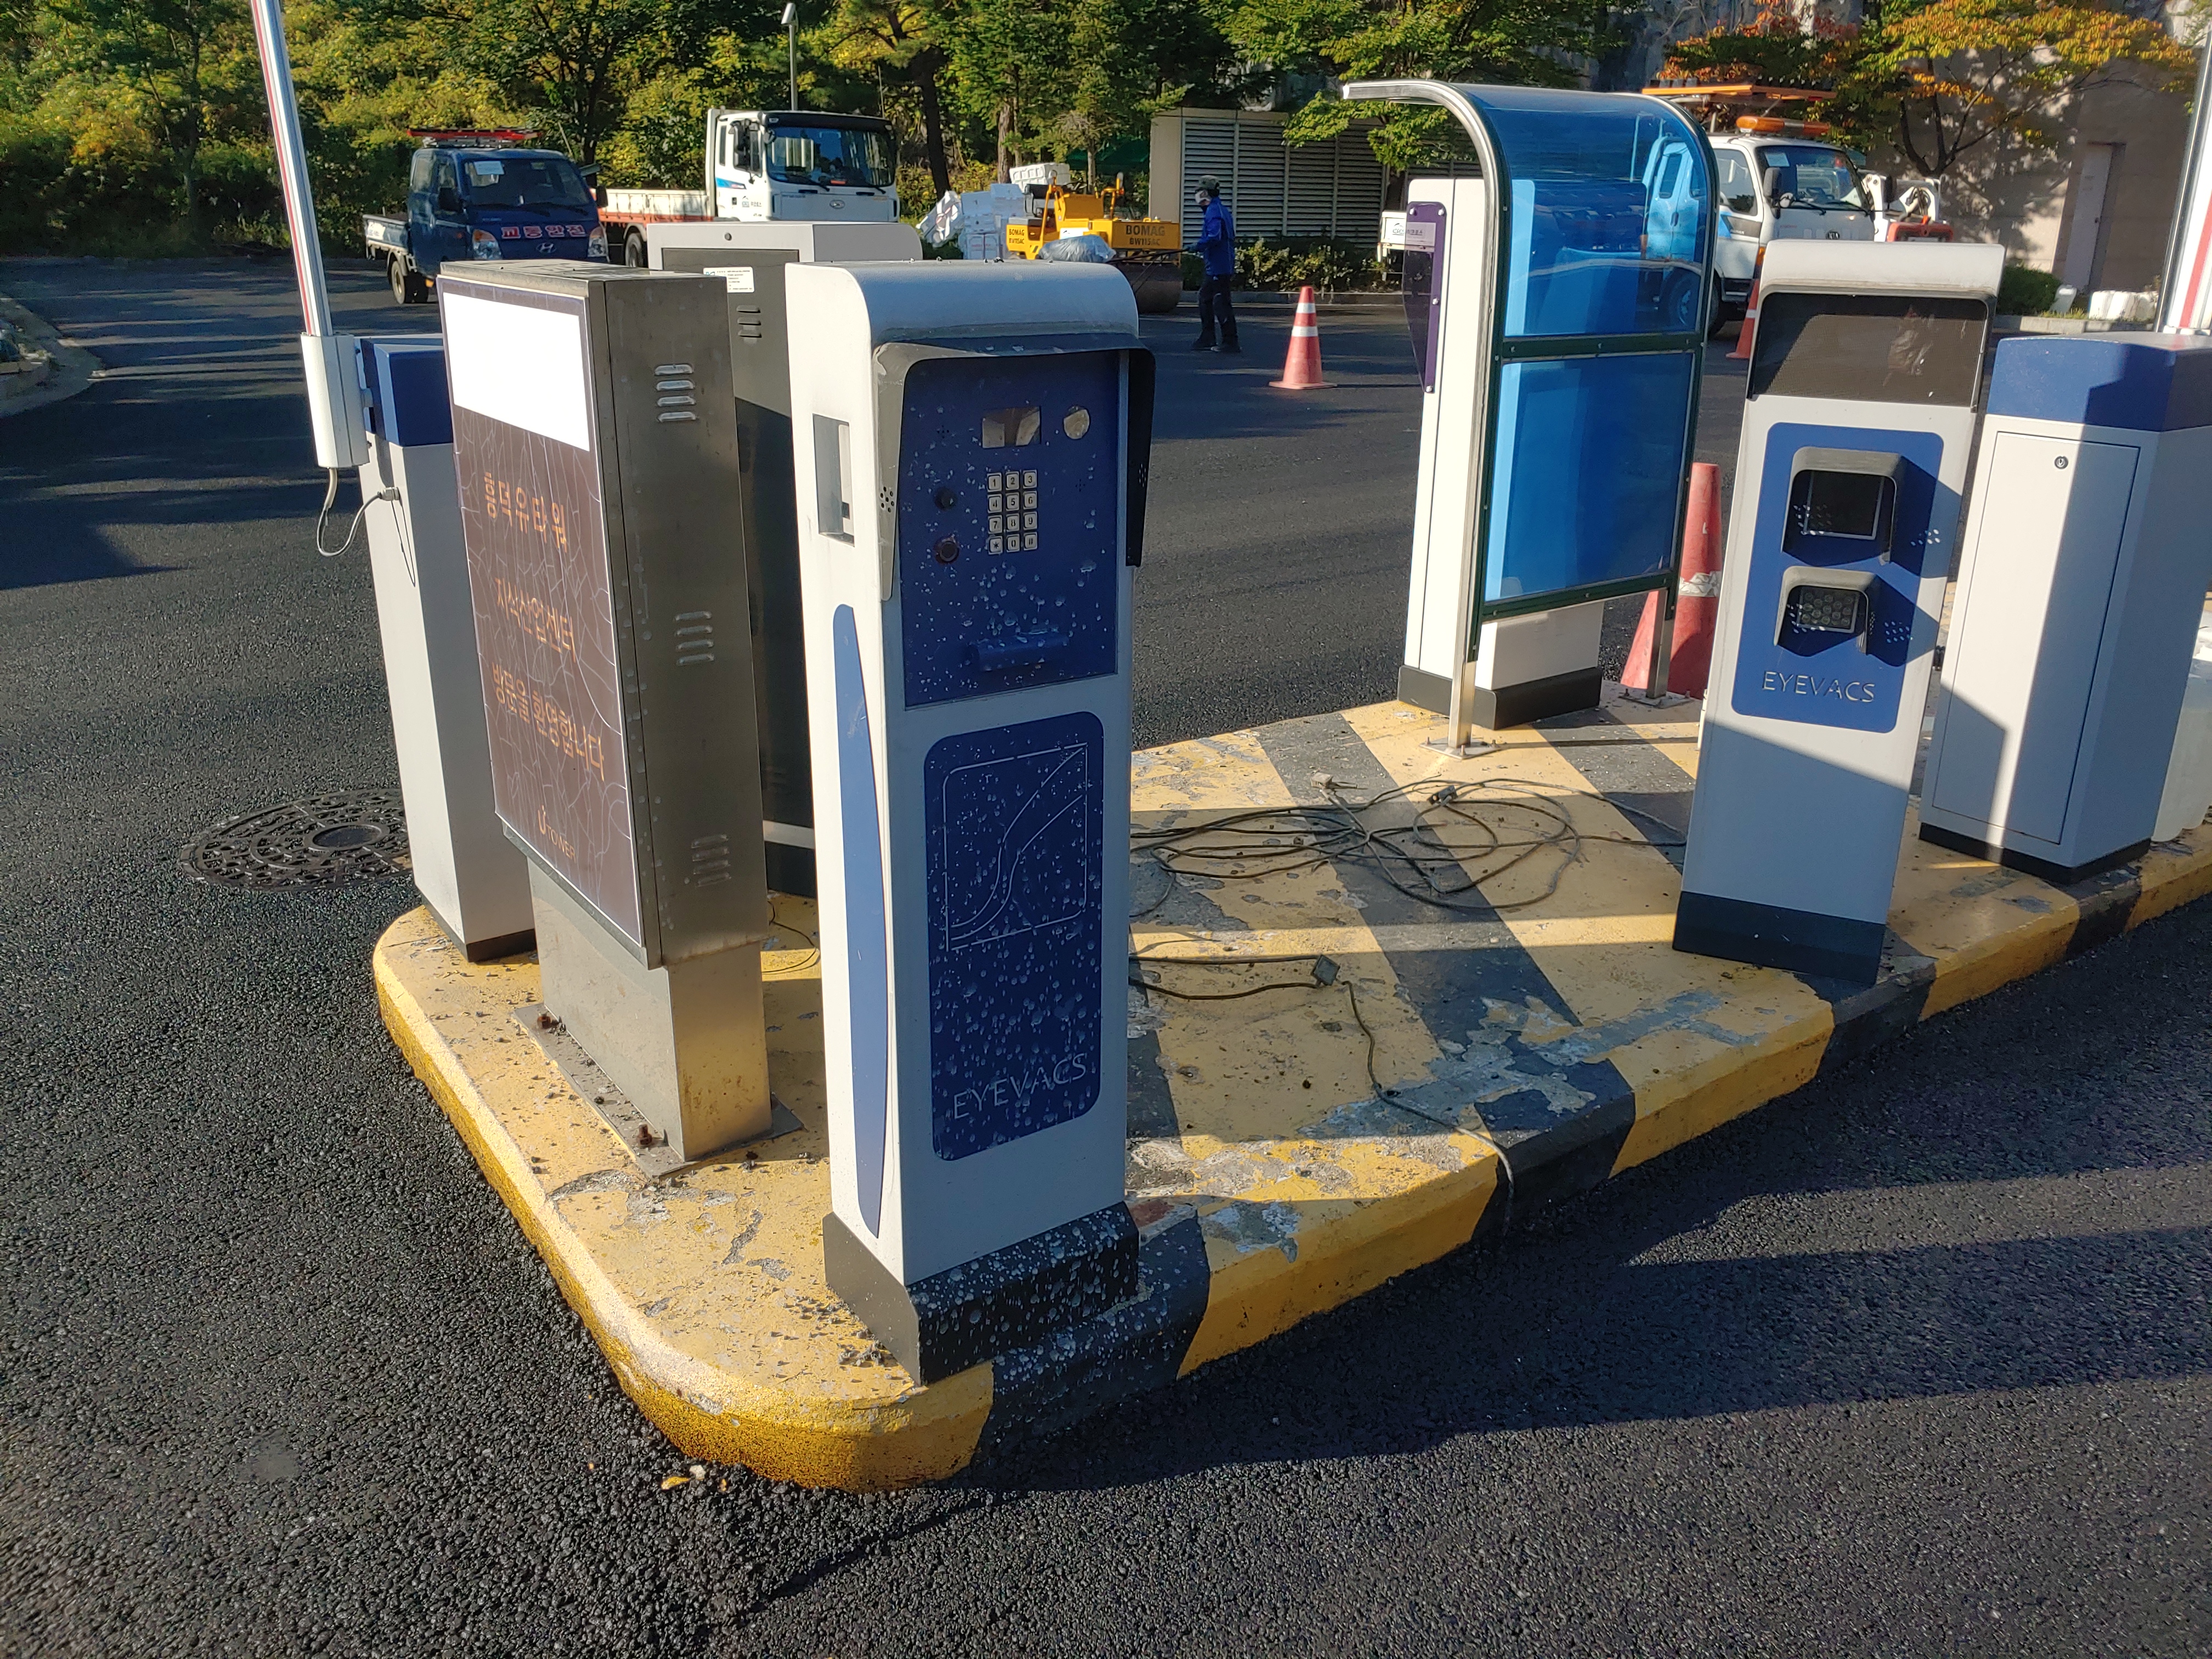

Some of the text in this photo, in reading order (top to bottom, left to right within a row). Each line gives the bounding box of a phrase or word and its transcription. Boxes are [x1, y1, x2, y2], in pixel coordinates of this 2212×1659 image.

[501, 224, 587, 239] 교통안전
[1126, 225, 1165, 236] BOMAG
[1011, 477, 1015, 485] 2
[1028, 475, 1032, 483] 3
[992, 499, 998, 508] 4
[1011, 498, 1015, 506] 5
[993, 521, 998, 529] 7
[1029, 517, 1033, 525] 9
[1011, 539, 1016, 548] 0
[494, 577, 576, 663] 지식산업센터
[1762, 670, 1875, 703] EYEVACS
[492, 662, 606, 782] 방문을 환영합니다
[953, 1053, 1087, 1119] EYEVACS
